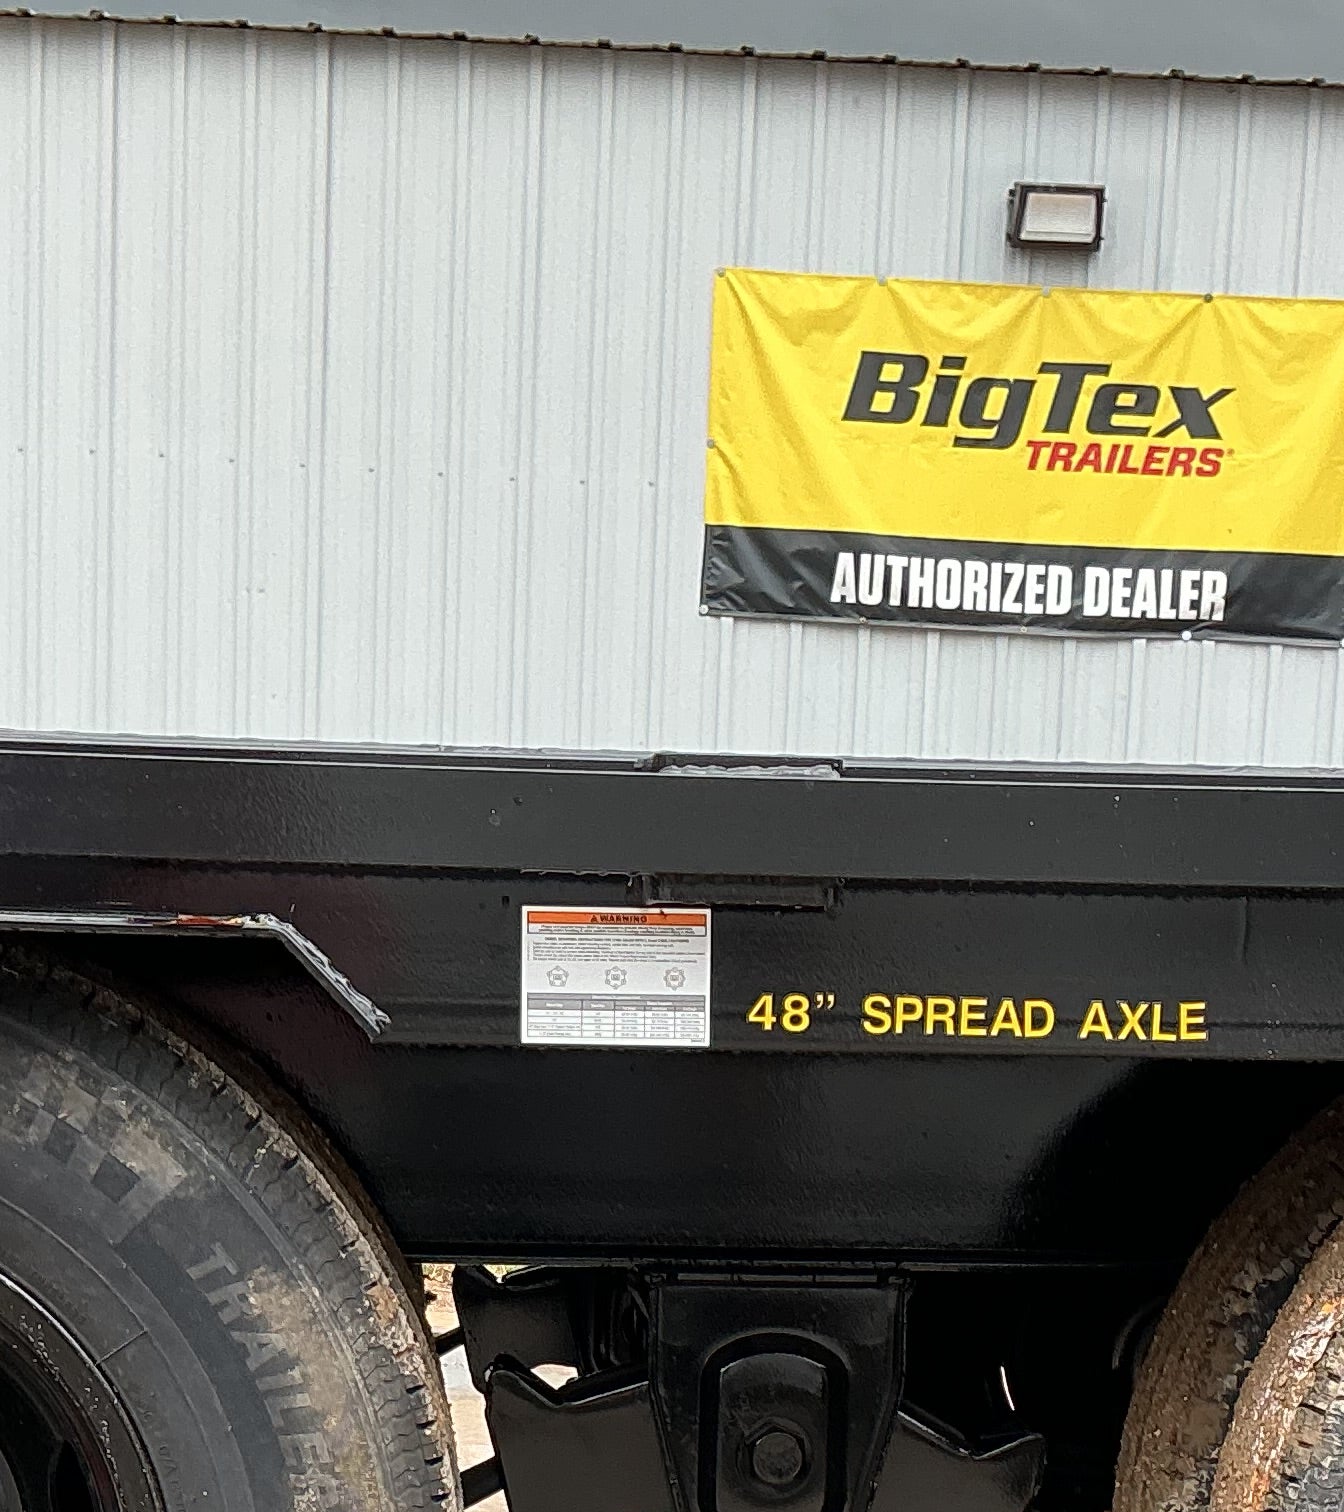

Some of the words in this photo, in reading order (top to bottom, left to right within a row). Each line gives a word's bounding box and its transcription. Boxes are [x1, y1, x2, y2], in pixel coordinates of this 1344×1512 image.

[841, 350, 1236, 449] BigTex
[1026, 440, 1225, 478] TRAILERS
[830, 552, 1072, 617] AUTHORIZED
[1082, 565, 1228, 623] DEALER
[862, 995, 1056, 1039] SPREAD
[1080, 1000, 1209, 1041] AXLE
